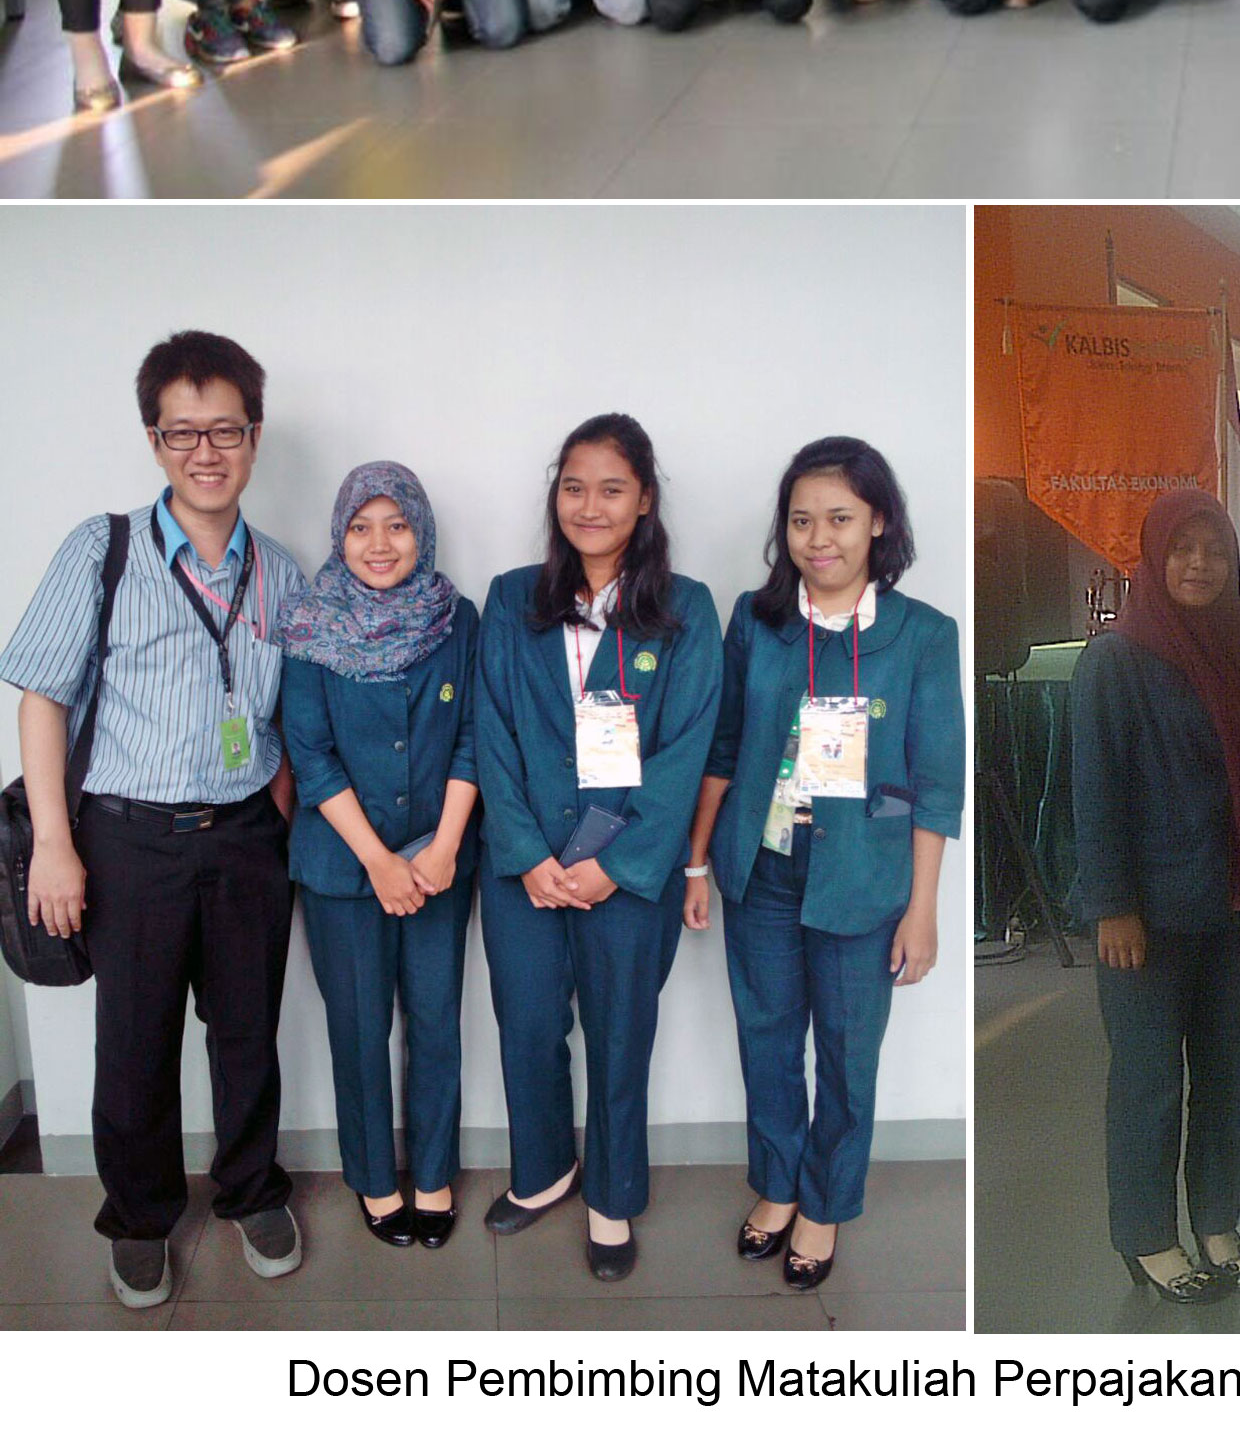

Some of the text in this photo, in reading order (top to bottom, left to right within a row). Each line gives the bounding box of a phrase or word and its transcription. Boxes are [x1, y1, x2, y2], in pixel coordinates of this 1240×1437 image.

[1064, 334, 1130, 358] KALBIS
[1050, 474, 1199, 492] FAKULTAS EKONOMI
